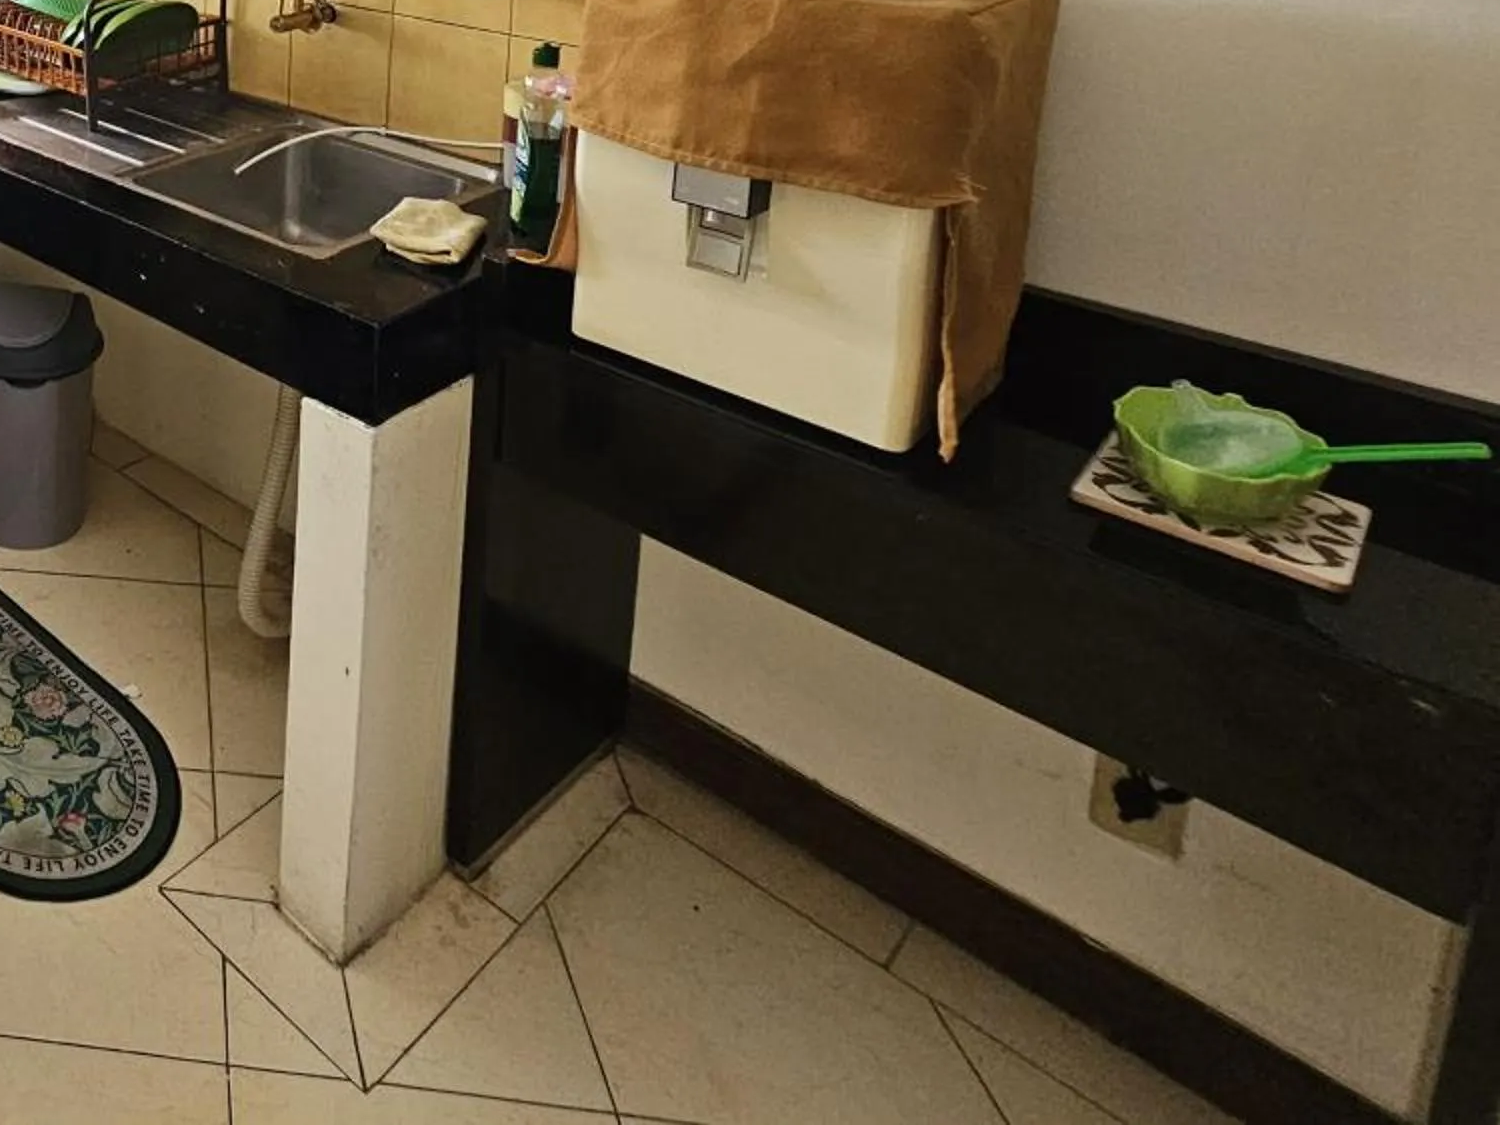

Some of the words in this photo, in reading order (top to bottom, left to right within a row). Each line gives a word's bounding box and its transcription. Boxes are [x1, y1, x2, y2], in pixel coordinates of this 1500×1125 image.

[26, 641, 43, 657] TO
[46, 660, 90, 695] ENJOY
[88, 698, 120, 725] LIFE
[119, 729, 147, 767] TAKE
[135, 774, 153, 814] TIME
[125, 818, 146, 838] TO
[23, 857, 65, 873] LIFE
[74, 837, 128, 873] ENJOY
